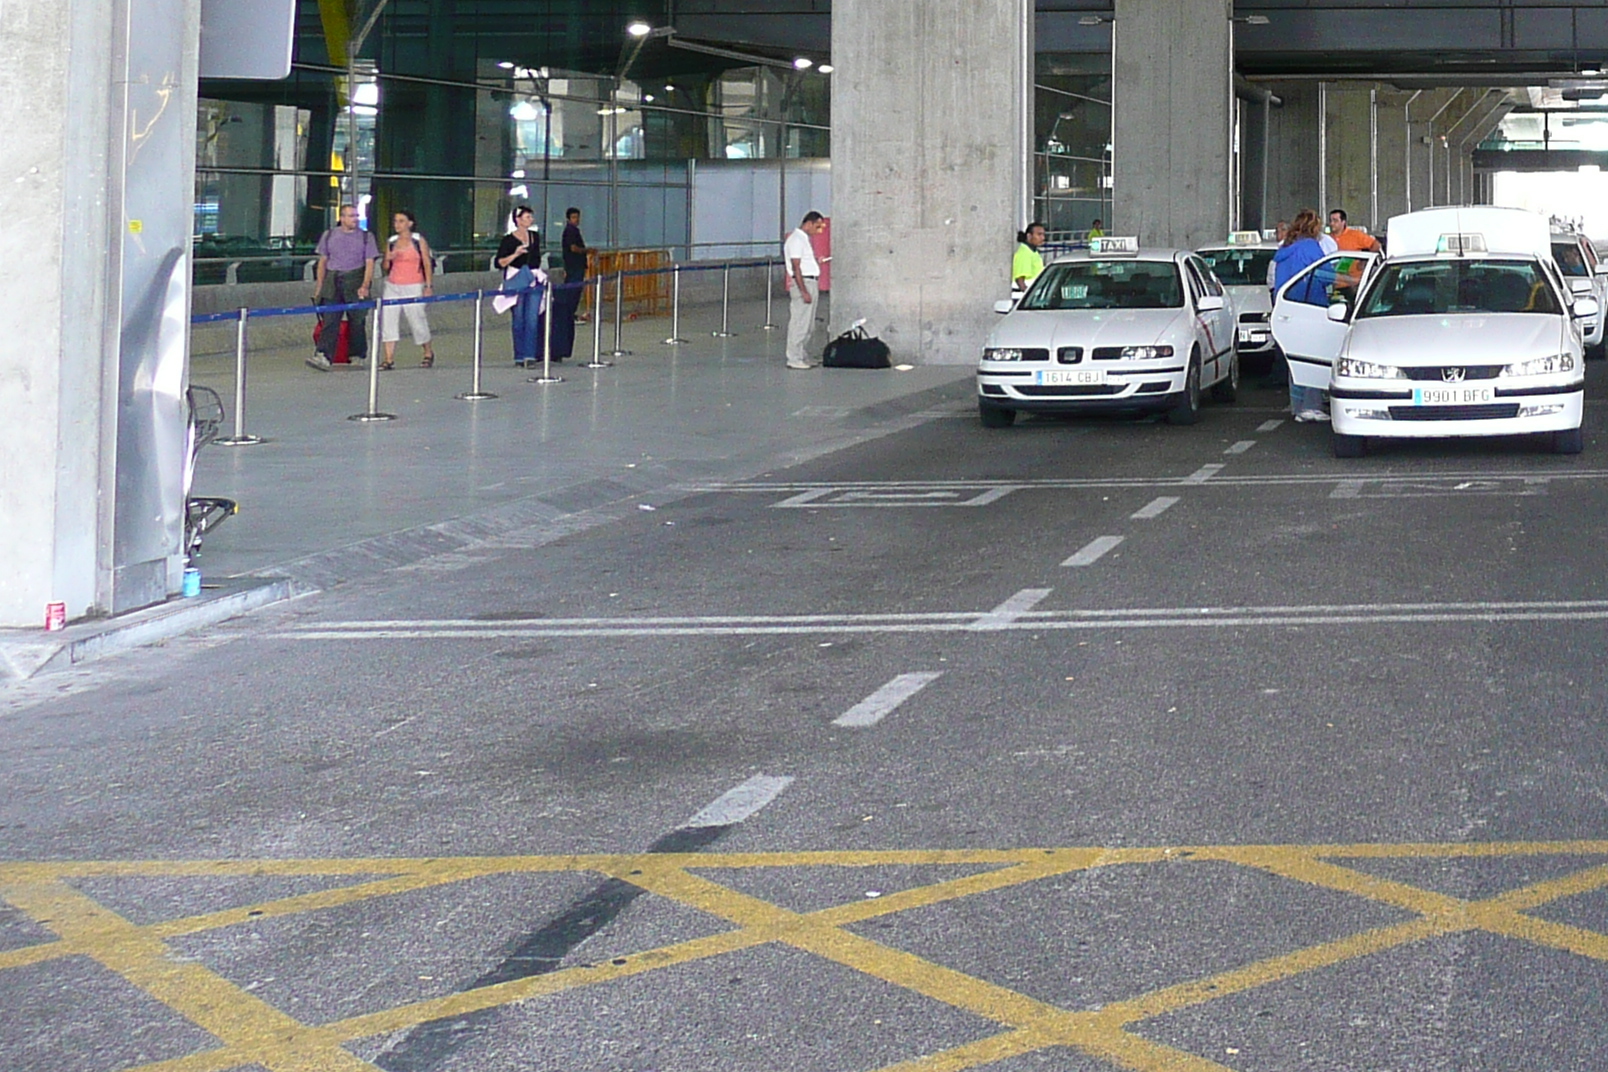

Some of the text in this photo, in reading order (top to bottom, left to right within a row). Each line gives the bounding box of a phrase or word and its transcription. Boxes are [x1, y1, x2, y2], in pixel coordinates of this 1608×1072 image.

[1102, 240, 1125, 250] TAXI
[1046, 372, 1072, 383] 1614
[1077, 372, 1099, 383] CBJ
[1423, 389, 1490, 403] 9901 BFG
